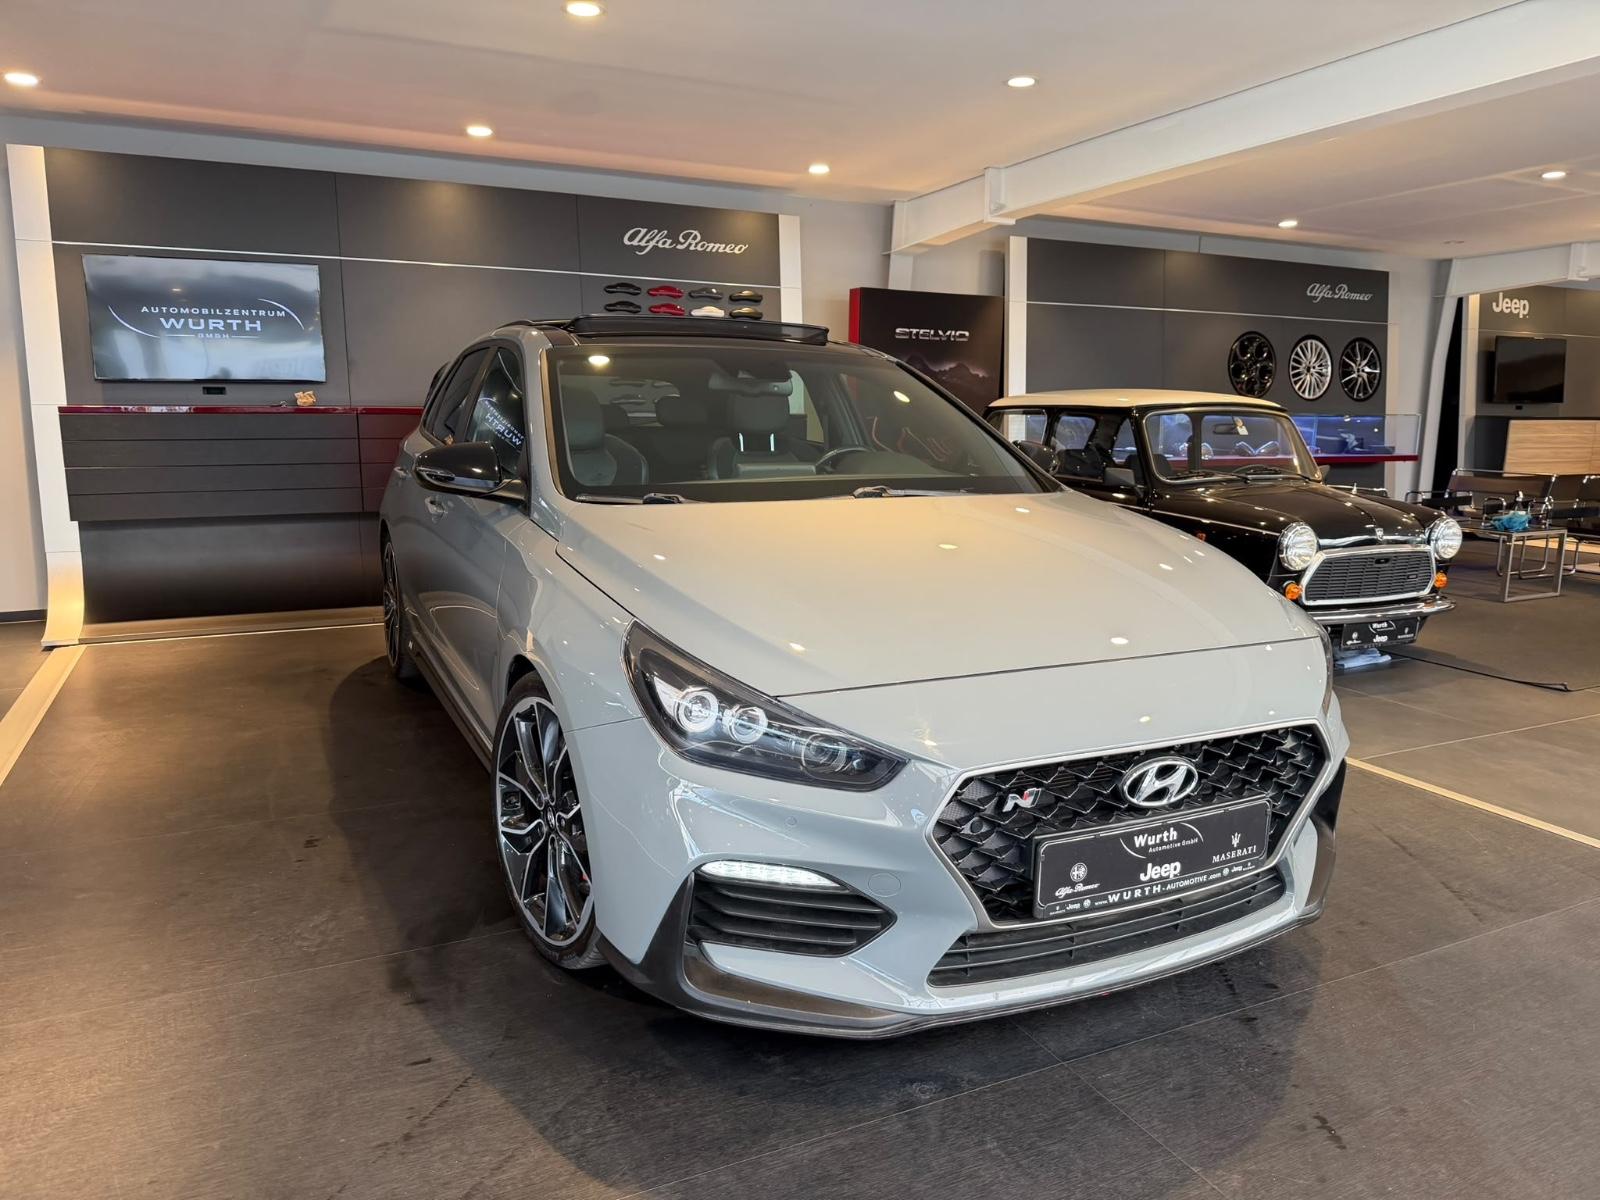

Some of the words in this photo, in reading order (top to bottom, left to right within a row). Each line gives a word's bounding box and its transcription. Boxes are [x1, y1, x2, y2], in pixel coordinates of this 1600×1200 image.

[623, 227, 676, 255] Alfa
[676, 229, 749, 254] Romeo
[1306, 282, 1333, 303] Alfa
[1334, 283, 1373, 301] Romeo
[141, 306, 286, 317] AUTOMOBILZENTRUM
[1492, 292, 1529, 318] Jeep
[159, 317, 262, 332] WURTH
[895, 327, 970, 342] STELVIO
[1133, 827, 1178, 848] Wurth
[1148, 842, 1181, 853] Automotive
[1181, 837, 1199, 847] GmbH
[1212, 845, 1257, 863] MASERATI
[1140, 861, 1181, 882] Jeep
